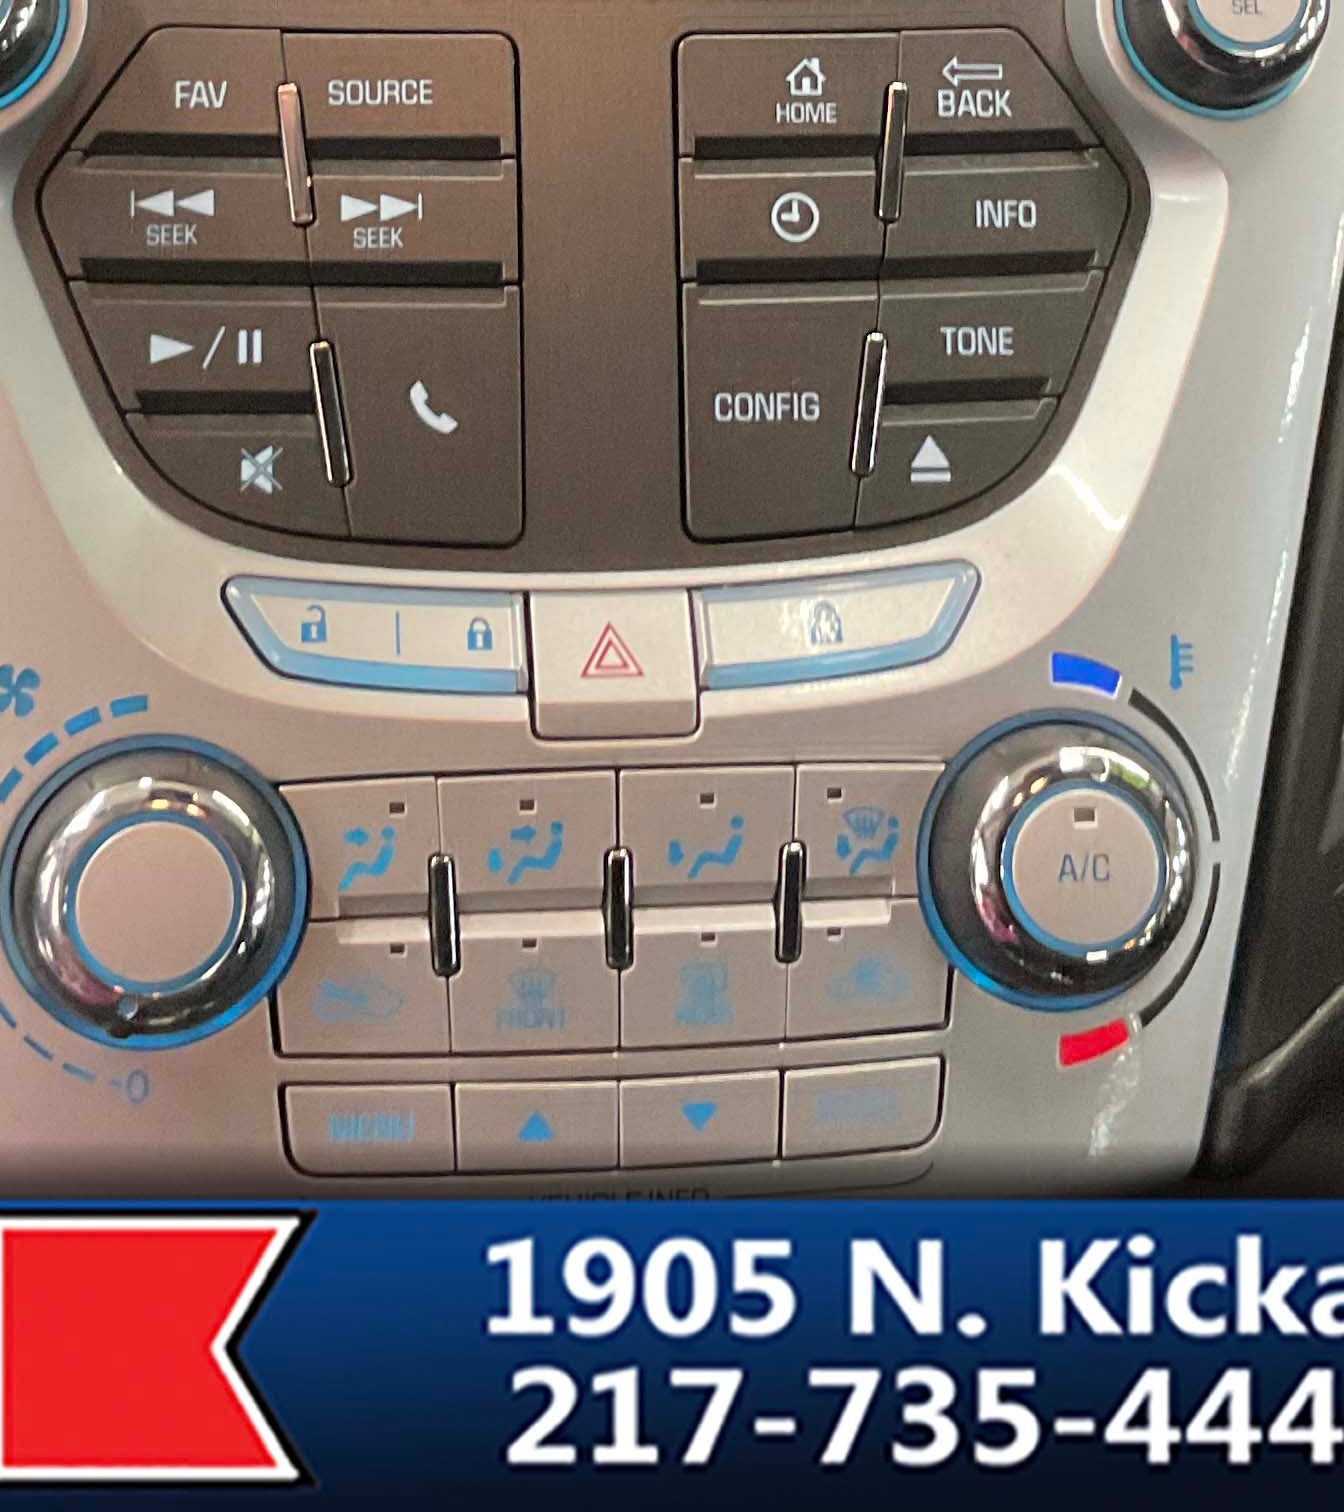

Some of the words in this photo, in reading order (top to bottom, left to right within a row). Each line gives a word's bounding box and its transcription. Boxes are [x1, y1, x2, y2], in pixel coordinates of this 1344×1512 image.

[174, 80, 228, 110] FAV
[327, 78, 434, 107] SOURCE
[936, 89, 1013, 119] BACK
[775, 101, 838, 125] HOME
[975, 199, 1038, 229] INFO
[145, 223, 199, 247] SEEK
[352, 226, 405, 250] SEEK
[939, 326, 1015, 357] TONE
[713, 391, 821, 423] CONFIG
[1057, 852, 1112, 884] A/C
